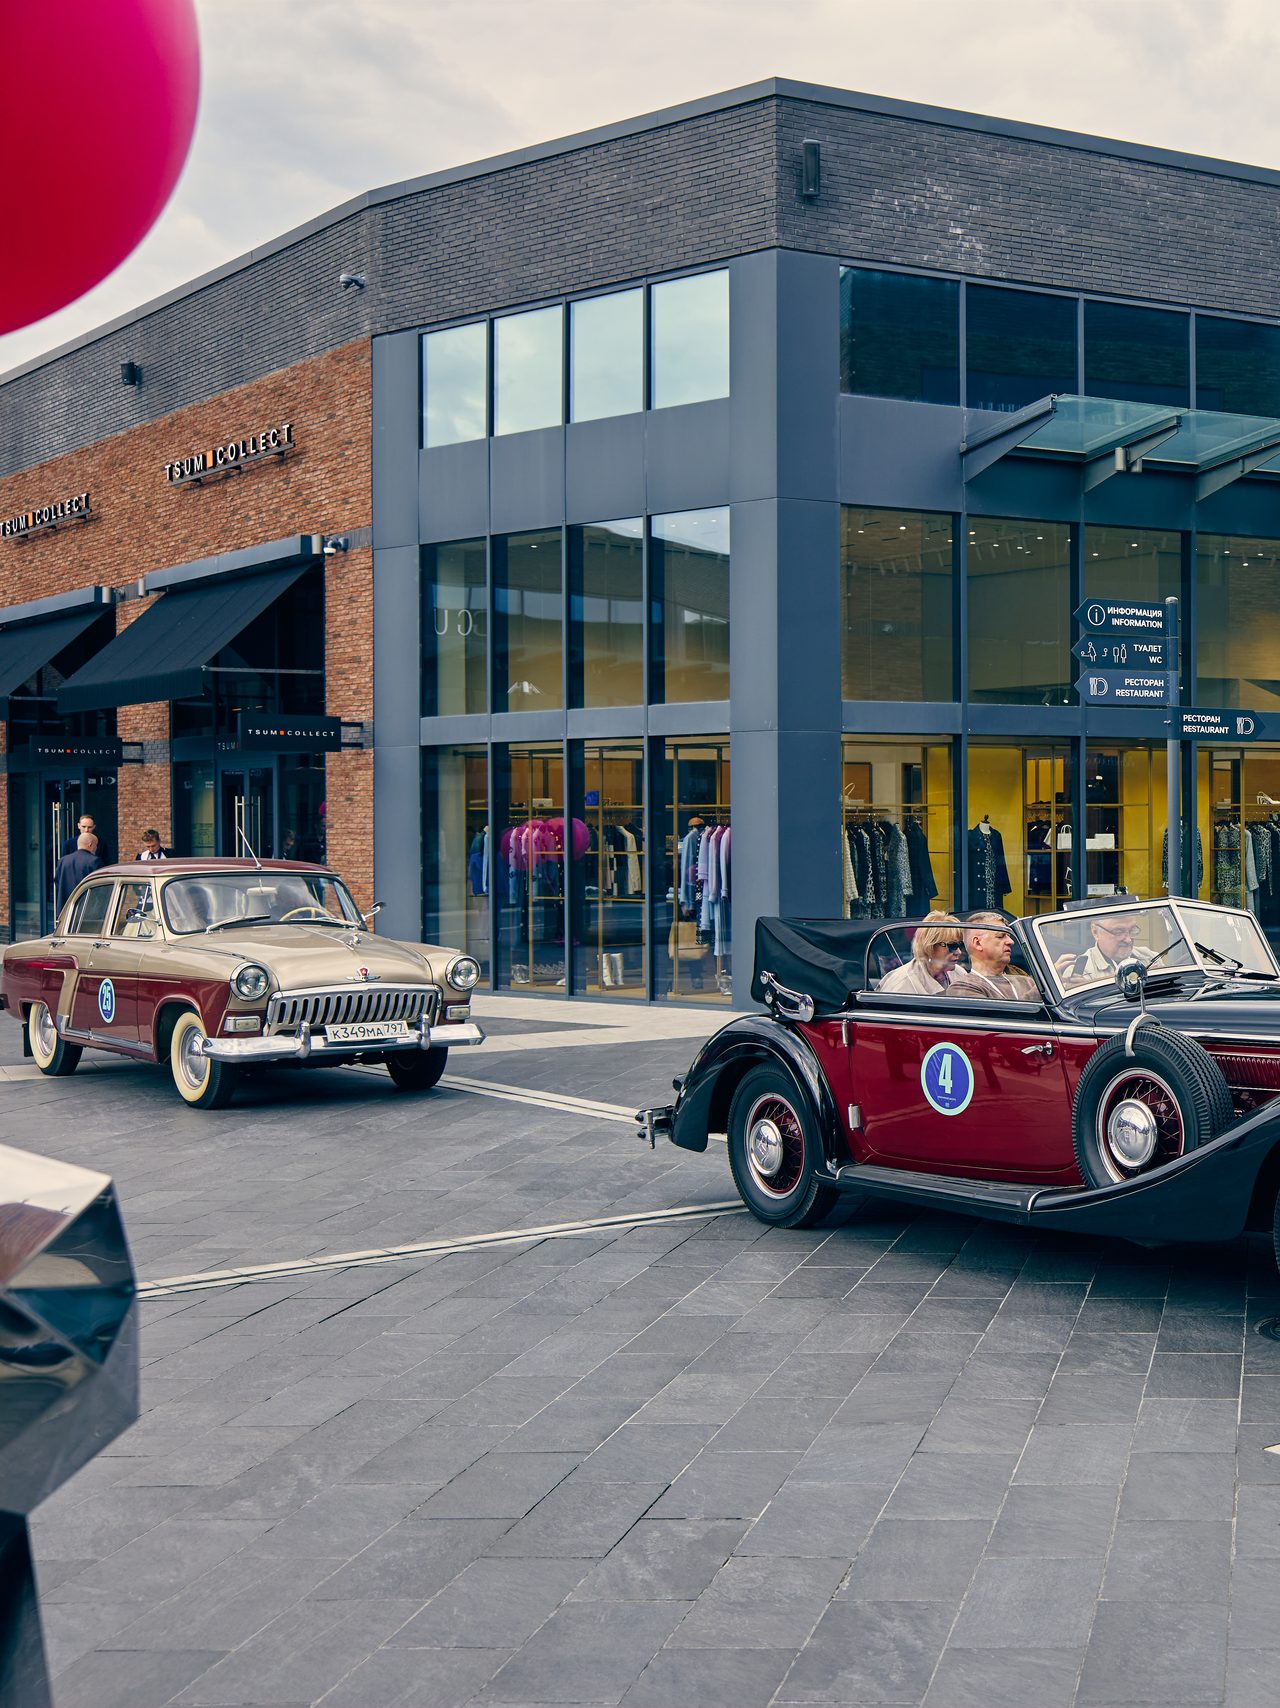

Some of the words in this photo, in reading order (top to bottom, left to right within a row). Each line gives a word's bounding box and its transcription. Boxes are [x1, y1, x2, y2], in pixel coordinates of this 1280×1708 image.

[164, 454, 204, 481] TSUM
[216, 424, 290, 464] COLLECT
[0, 514, 26, 537] TSUM
[35, 492, 87, 525] COLLECT
[1107, 606, 1163, 618] ИНФОРМАЦИЯ
[1111, 618, 1163, 629] INFORMATION
[1133, 644, 1163, 653] ТУАЛЕТ
[1149, 656, 1163, 664] WC
[1124, 678, 1164, 687] РЕСТОРАН
[1115, 689, 1164, 698] RESTAURANT
[1183, 714, 1221, 724] РЕСТОРАН
[1183, 725, 1230, 734] RESTAURANT
[102, 984, 111, 1011] 25
[938, 1053, 953, 1094] 4
